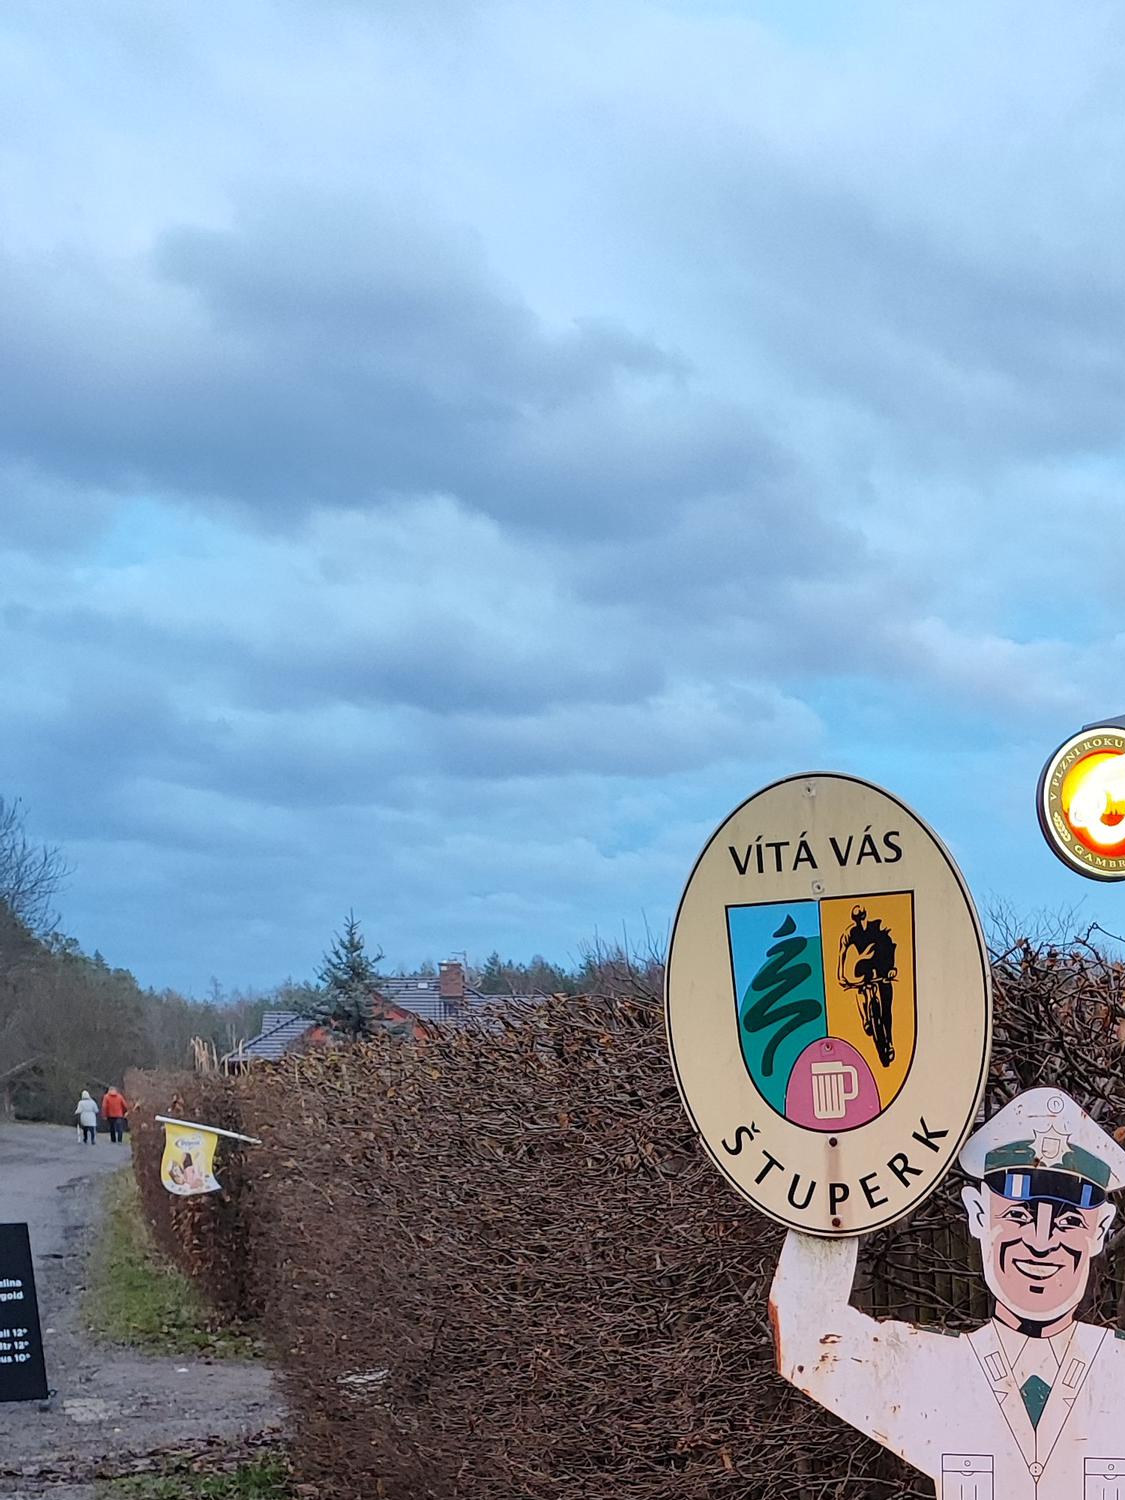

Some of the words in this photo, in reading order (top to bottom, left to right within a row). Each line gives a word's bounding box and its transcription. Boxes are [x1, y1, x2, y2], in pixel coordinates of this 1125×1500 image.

[1050, 793, 1057, 801] V
[1083, 738, 1124, 751] ROKU
[728, 831, 818, 876] VÍTÁ
[829, 825, 904, 866] VÁS
[721, 1116, 950, 1216] ŠTUPERK
